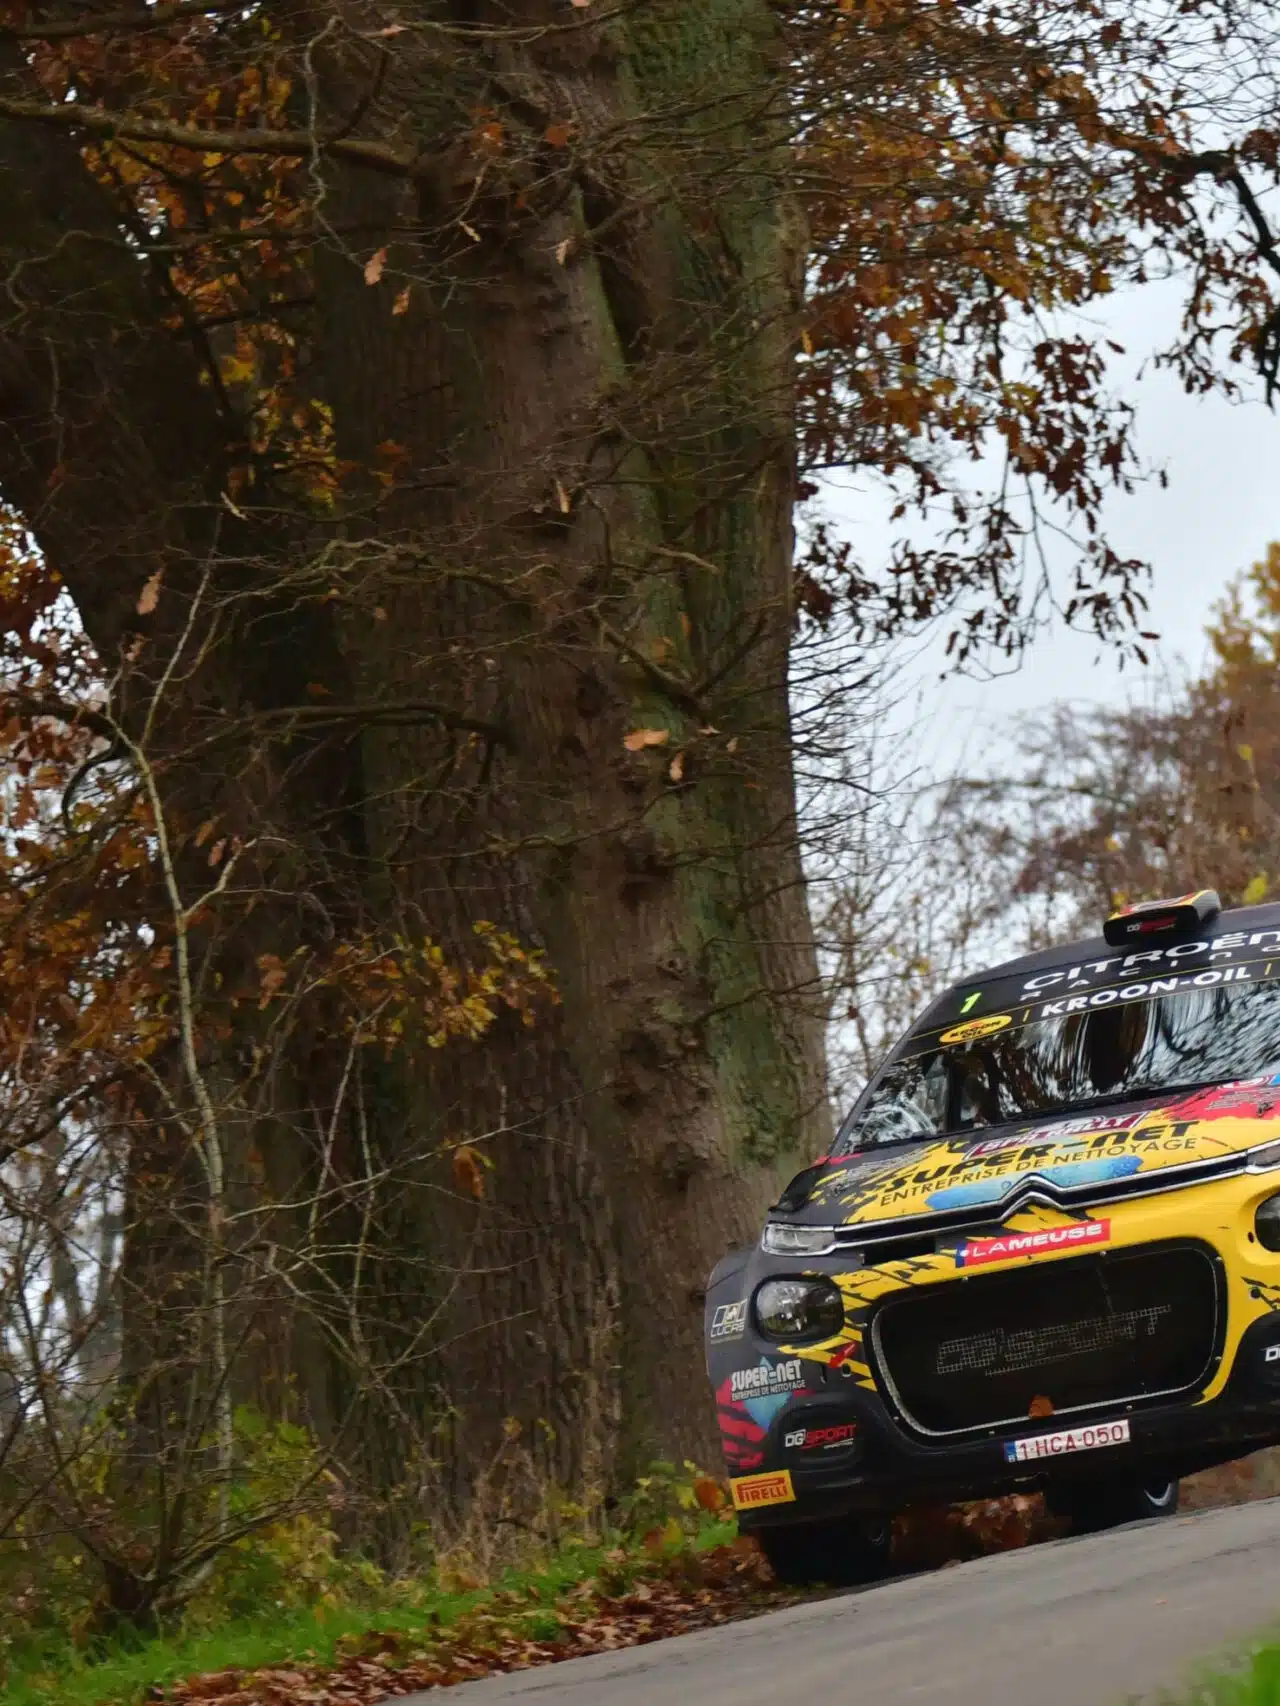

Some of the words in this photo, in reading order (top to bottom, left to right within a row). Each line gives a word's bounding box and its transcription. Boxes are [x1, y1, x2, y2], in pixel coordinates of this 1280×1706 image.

[960, 992, 982, 1014] 1
[1041, 967, 1251, 1018] KROON-OIL
[880, 1164, 1006, 1206] ENTREPRISE
[1015, 1158, 1045, 1172] DE
[1053, 1137, 1198, 1165] NETTOYAGE
[1020, 1424, 1124, 1459] 1-HCA-050
[736, 1477, 789, 1504] PIRELLI
